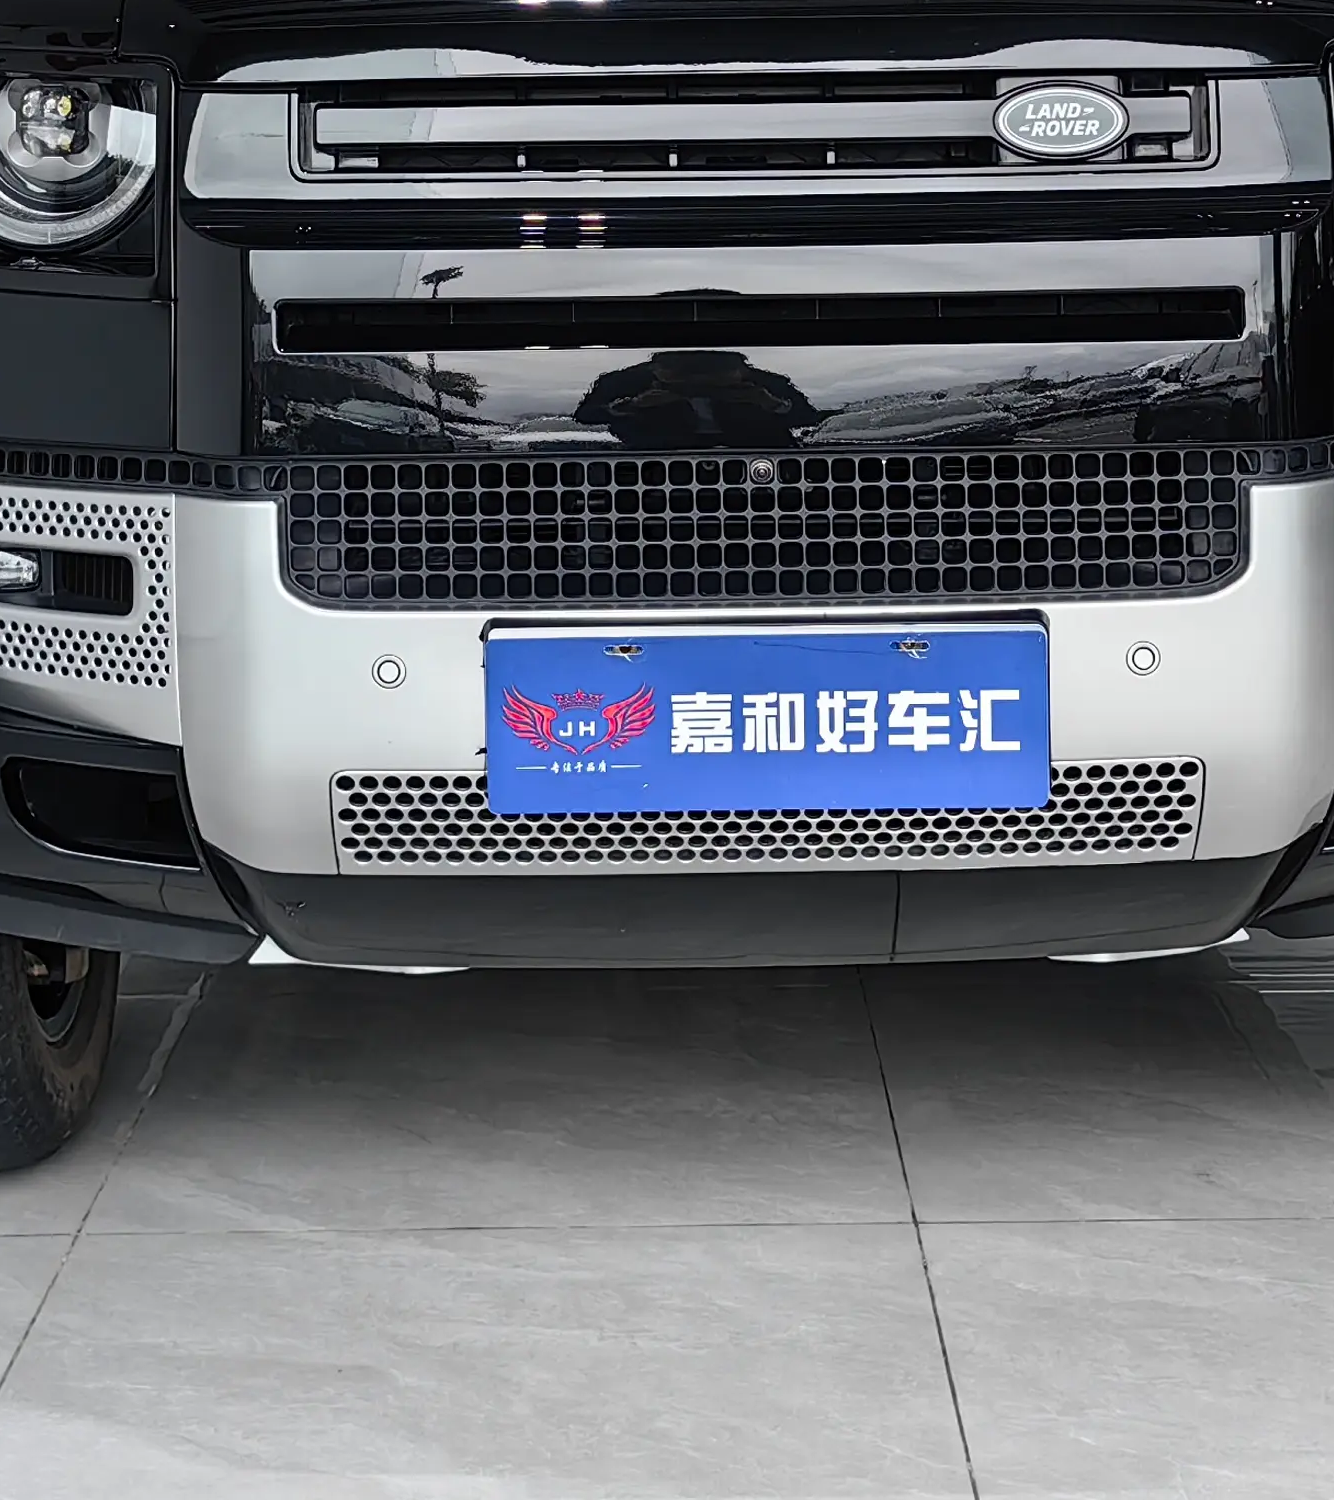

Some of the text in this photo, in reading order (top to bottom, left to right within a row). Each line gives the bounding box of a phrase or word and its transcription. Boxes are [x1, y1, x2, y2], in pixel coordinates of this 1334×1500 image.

[1025, 102, 1082, 120] LAND
[1030, 119, 1100, 137] ROVER
[559, 720, 596, 737] JH
[670, 688, 1021, 755] 嘉和好车汇
